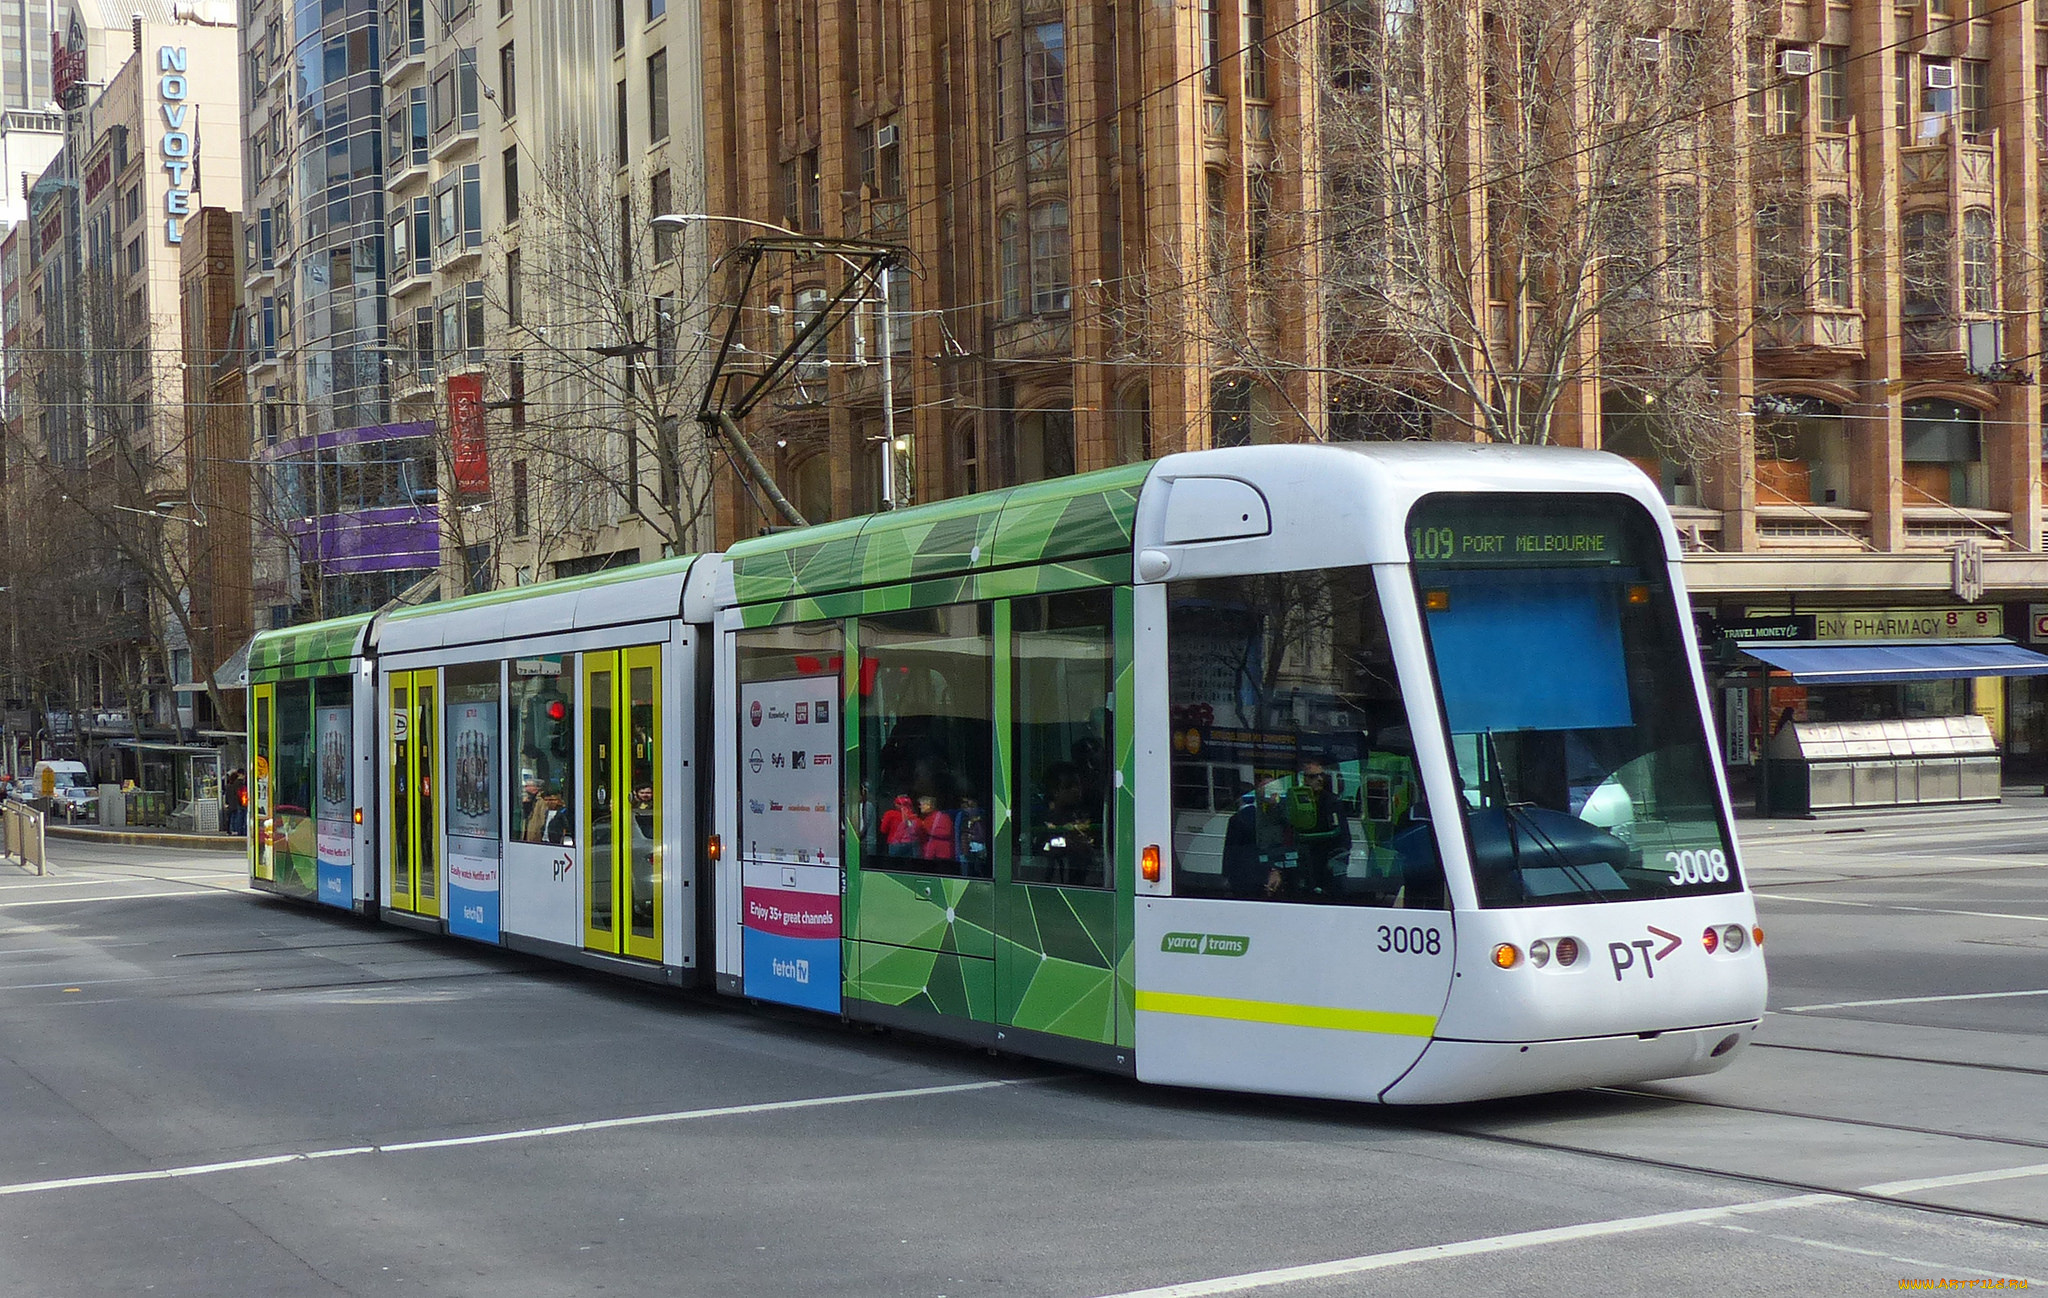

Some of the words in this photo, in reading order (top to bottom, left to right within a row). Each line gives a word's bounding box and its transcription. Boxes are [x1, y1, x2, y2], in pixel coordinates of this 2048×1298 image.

[160, 45, 190, 243] NOVOTEL
[1411, 527, 1455, 559] 109
[1462, 535, 1505, 552] PORT
[1515, 534, 1605, 551] MELBOURNE
[1853, 618, 1941, 636] PHARMACY
[1946, 611, 1958, 625] 8
[1976, 611, 1988, 624] 8
[1723, 629, 1755, 639] TRAVEL
[1756, 627, 1787, 638] MONEY
[813, 754, 832, 765] ESPN
[451, 864, 461, 879] Easily
[462, 871, 472, 880] watch
[473, 870, 485, 881] Netflix
[553, 859, 565, 882] PT
[1664, 848, 1730, 886] 3008
[750, 901, 769, 921] Enjoy
[769, 906, 783, 921] 35+
[783, 911, 801, 926] great
[801, 910, 834, 925] channels
[1166, 935, 1198, 950] yarra
[1208, 938, 1243, 951] trams
[1376, 925, 1442, 955] 3008
[1608, 939, 1655, 982] PT
